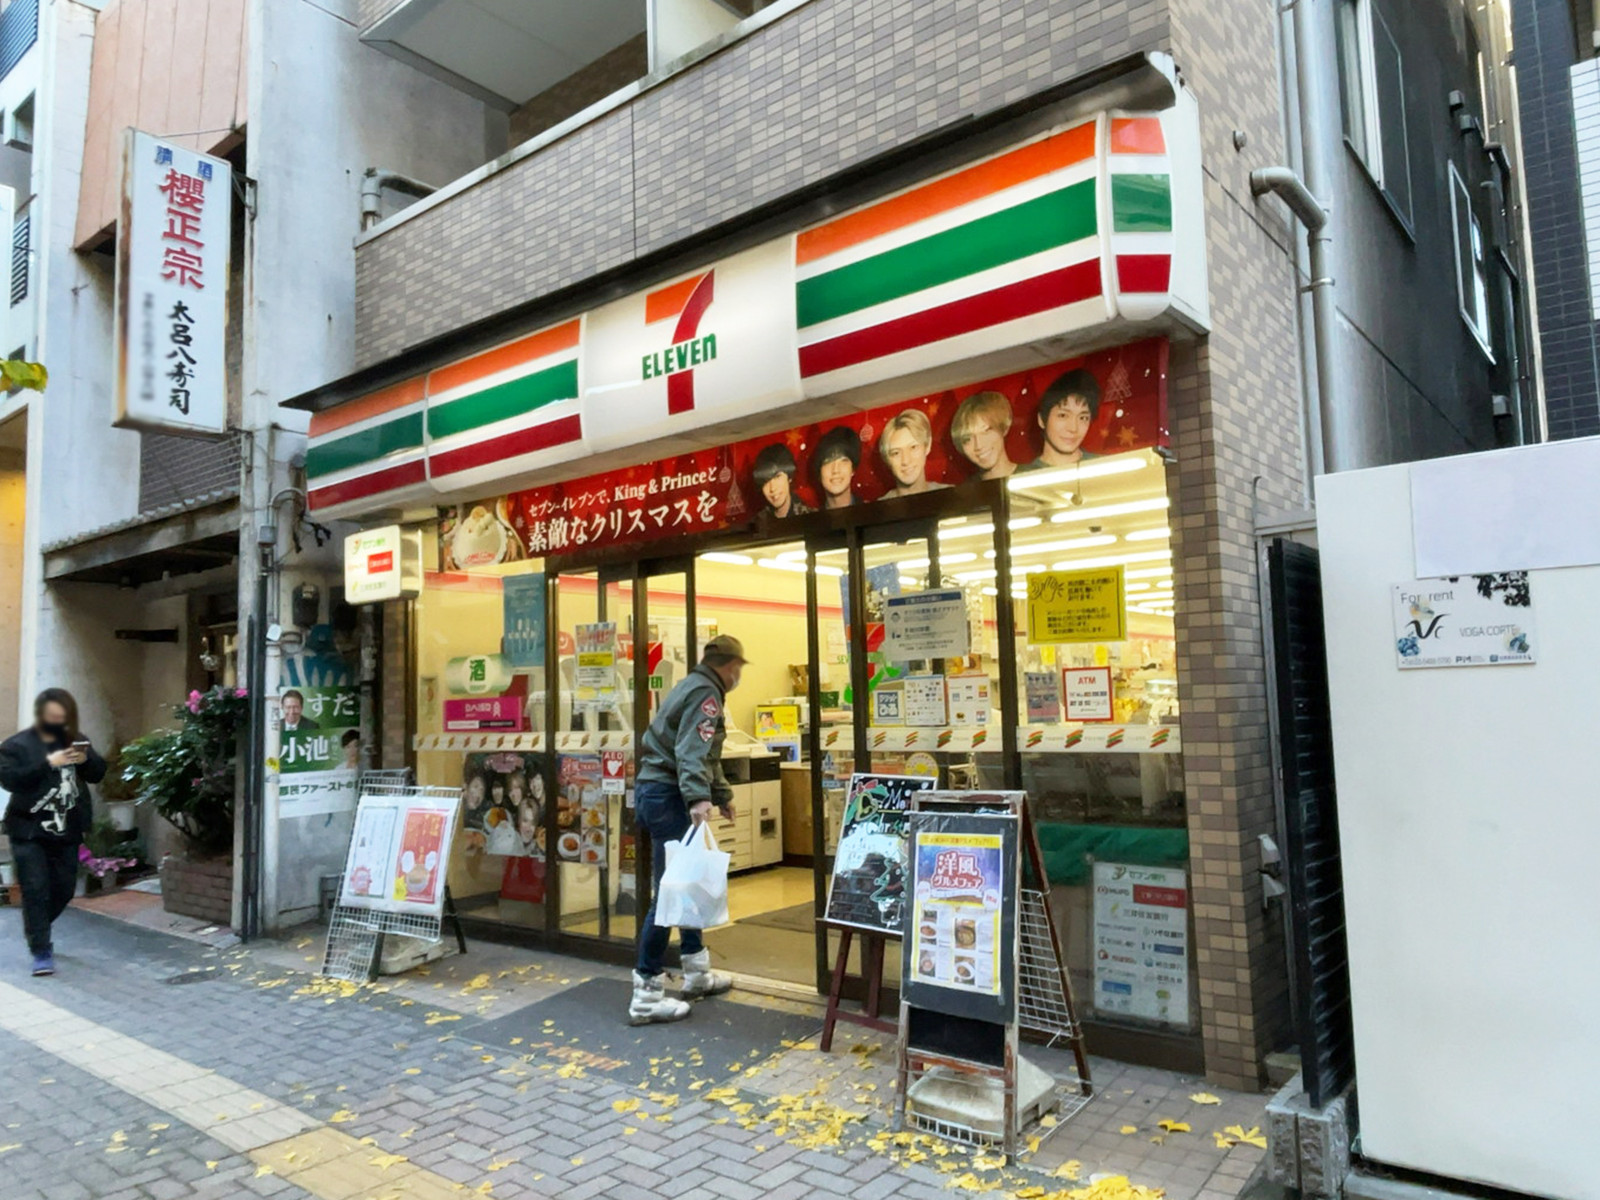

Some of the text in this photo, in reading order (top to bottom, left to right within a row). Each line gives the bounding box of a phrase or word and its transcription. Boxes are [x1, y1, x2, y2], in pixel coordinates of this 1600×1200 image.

[159, 167, 206, 290] 櫻正宗
[613, 481, 647, 502] King
[648, 478, 659, 494] &
[527, 489, 719, 555] 素敵なクリスマスを
[1428, 589, 1455, 602] rent
[469, 658, 487, 682] 酒
[1077, 676, 1097, 685] ATM
[279, 735, 329, 764] 小池
[603, 751, 624, 760] AED
[937, 852, 978, 877] 洋風
[933, 875, 982, 889] グルメフェア
